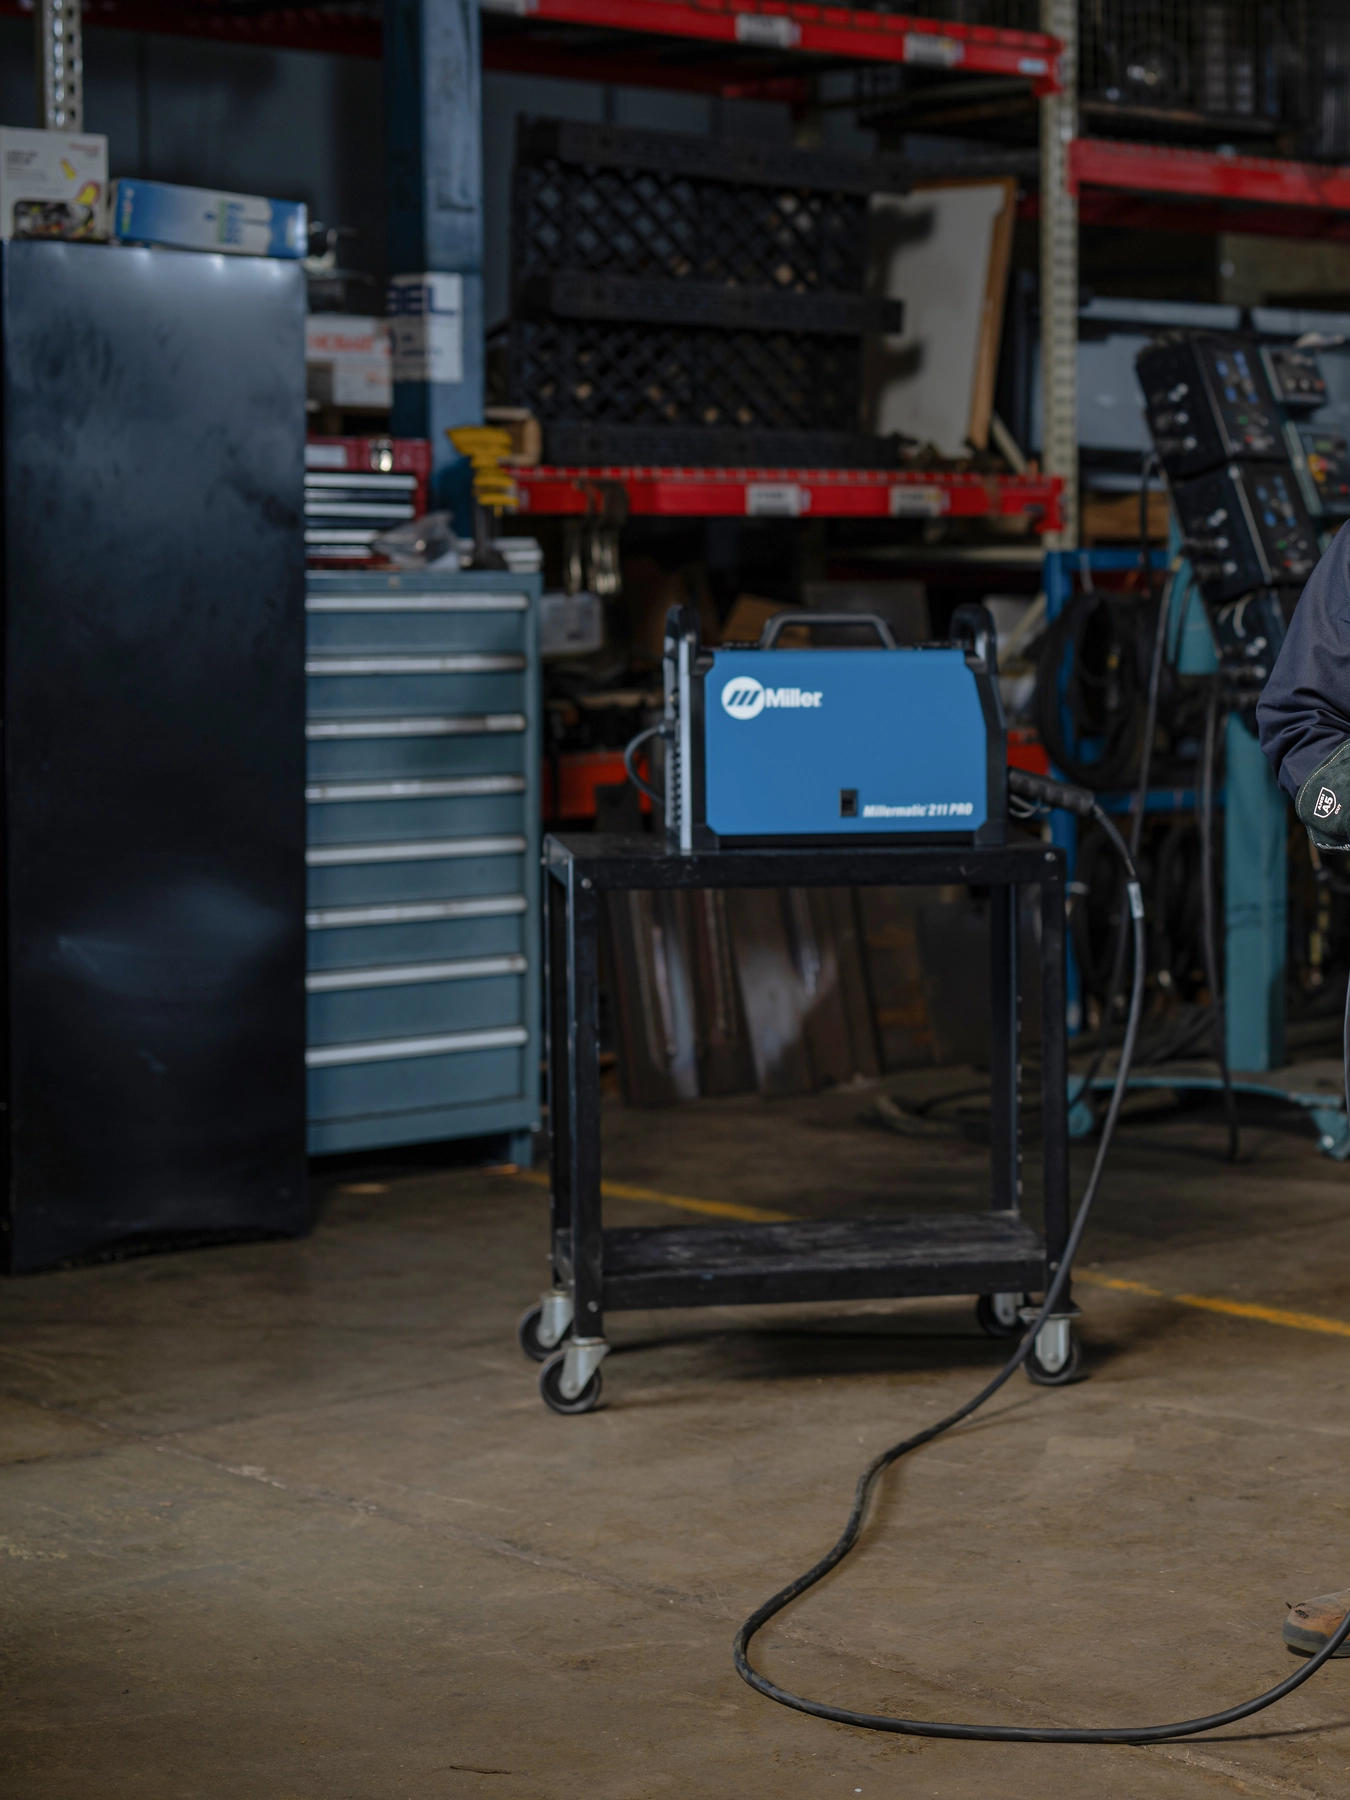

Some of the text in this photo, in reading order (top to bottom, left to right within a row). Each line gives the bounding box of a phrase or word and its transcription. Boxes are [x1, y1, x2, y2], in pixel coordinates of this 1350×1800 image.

[765, 687, 823, 708] Miller
[928, 803, 949, 817] 211
[949, 802, 973, 817] PRO
[1322, 795, 1334, 814] A5
